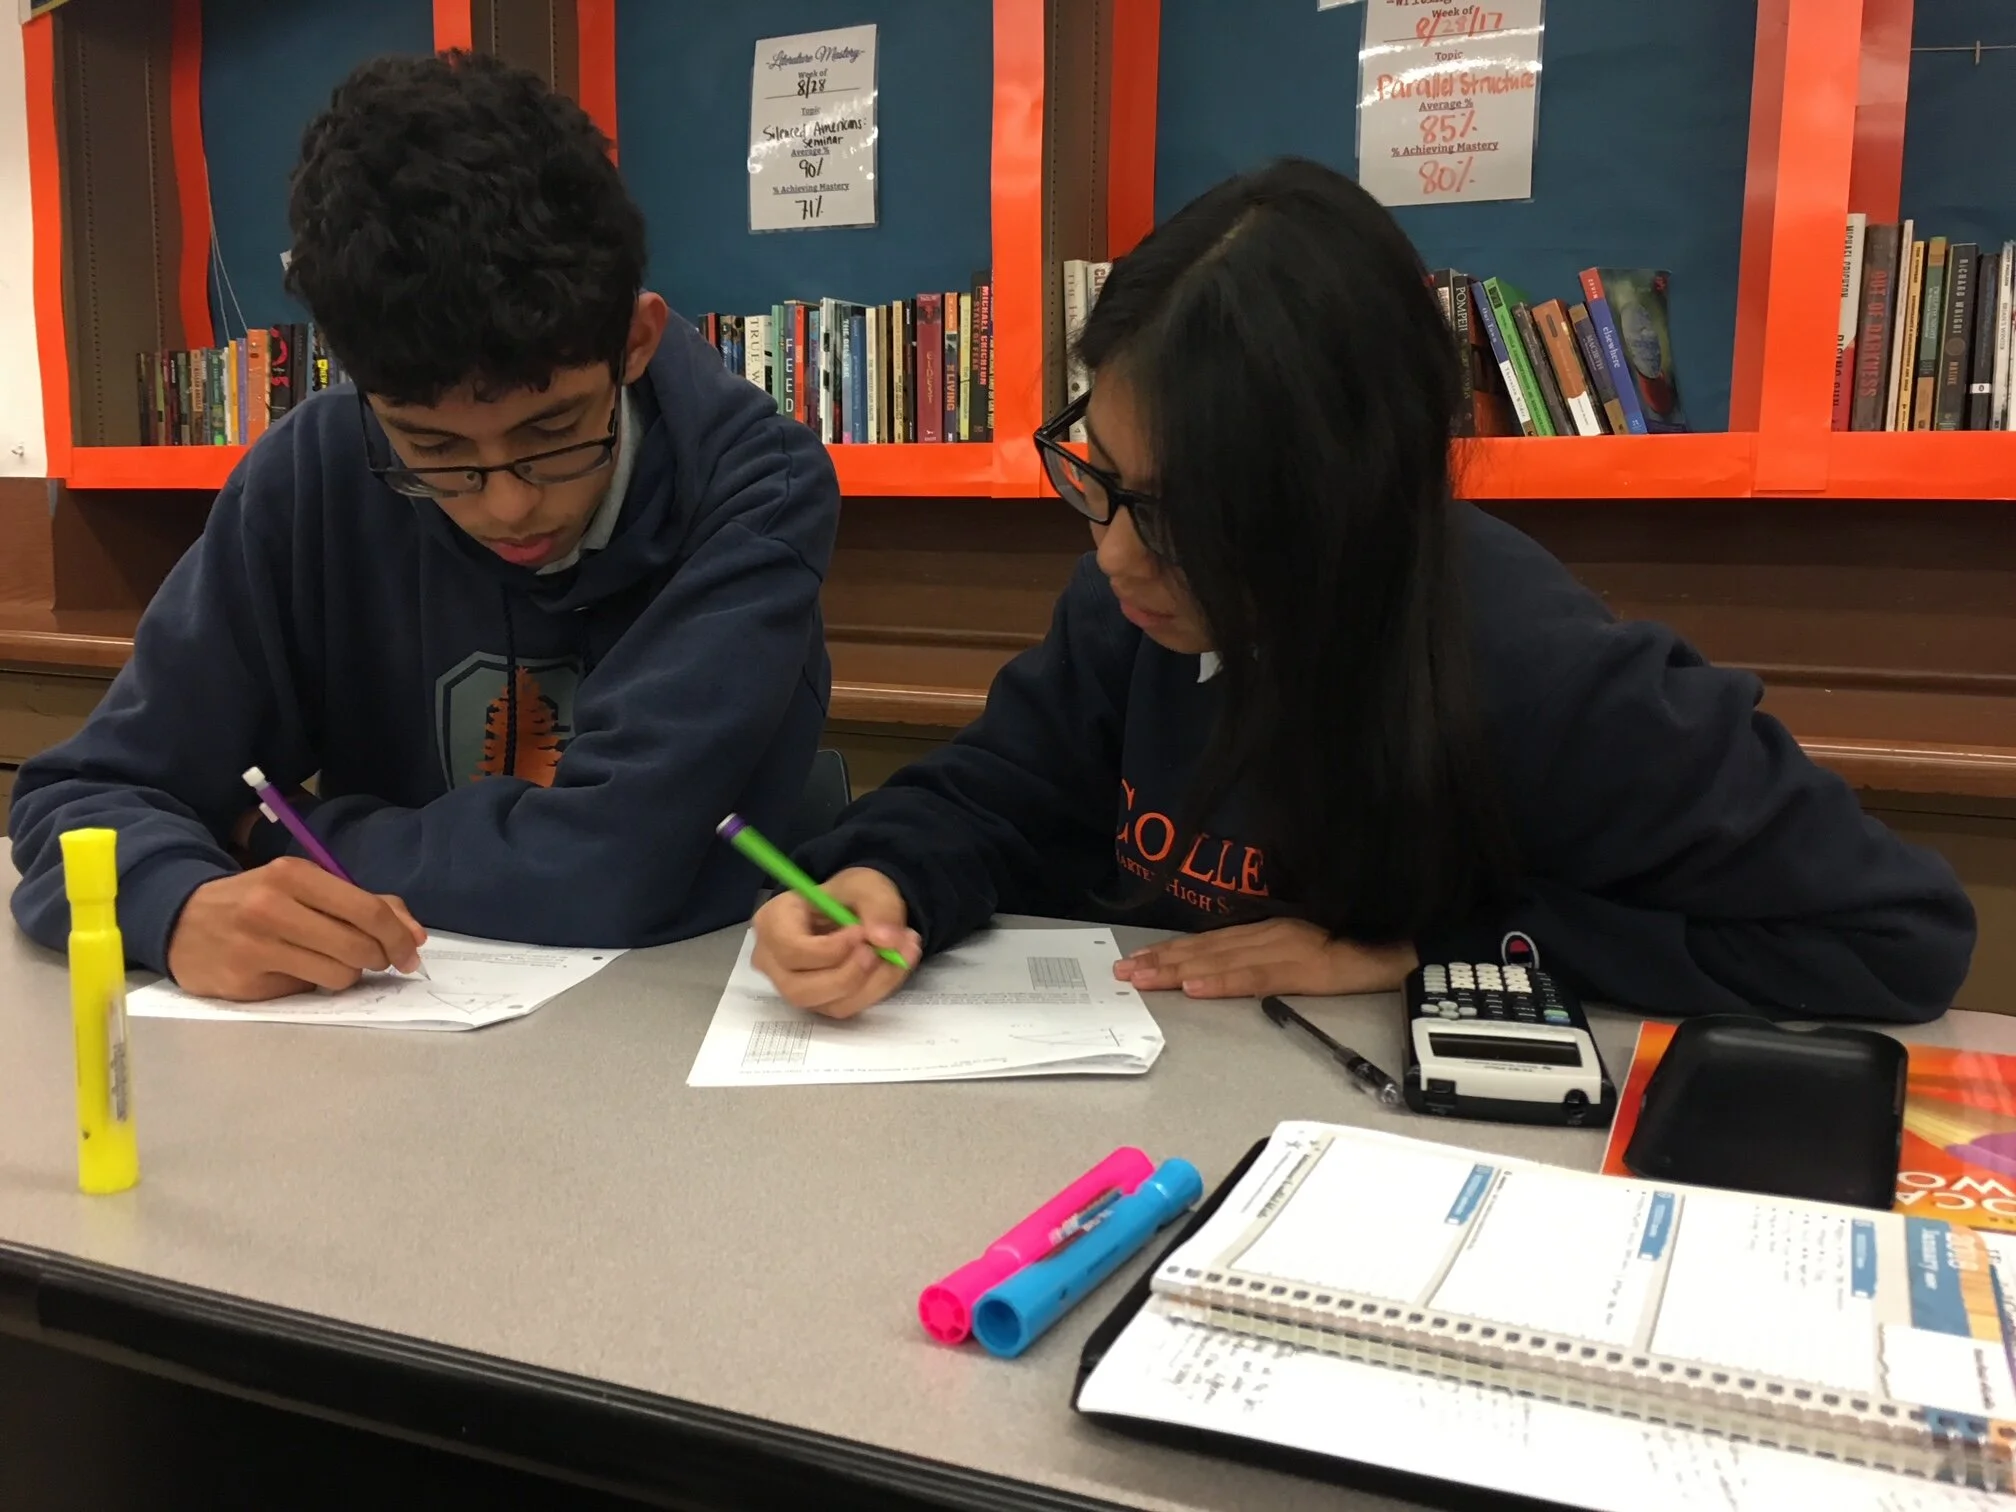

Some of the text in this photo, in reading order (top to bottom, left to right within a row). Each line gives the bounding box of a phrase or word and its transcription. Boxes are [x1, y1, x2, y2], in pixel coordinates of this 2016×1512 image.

[1415, 7, 1503, 47] 8/28/17
[1432, 6, 1474, 18] Week of
[1435, 50, 1464, 61] Topic
[797, 77, 827, 98] 8/28
[798, 69, 828, 79] Week of
[1376, 71, 1535, 100] Parallel Structure
[801, 107, 821, 116] Topic
[1419, 99, 1474, 112] Average %
[1419, 109, 1478, 144] 85%
[791, 148, 823, 157] Average
[1391, 141, 1499, 157] % Achieving Mastery
[799, 157, 824, 178] 90%
[1418, 156, 1476, 195] 80%
[773, 182, 849, 194] % Achieving Mastery
[795, 195, 823, 220] 71%
[1454, 286, 1468, 332] POMPEII
[1952, 258, 1969, 334] RICHARD WRIGHT
[751, 318, 760, 362] TRUE
[973, 332, 980, 345] OF
[980, 286, 989, 386] MICHAEL CRICHTON
[1602, 326, 1621, 369] elsewhere
[1861, 270, 1888, 398] OUT OF DARKNESS
[1585, 335, 1603, 371] MACBETH
[785, 338, 794, 412] FEED
[1947, 361, 1959, 386] NATIVE
[947, 374, 955, 411] LIVING
[1116, 778, 1269, 896] COLLE
[1165, 879, 1212, 912] HIGH
[1918, 1228, 1940, 1273] January
